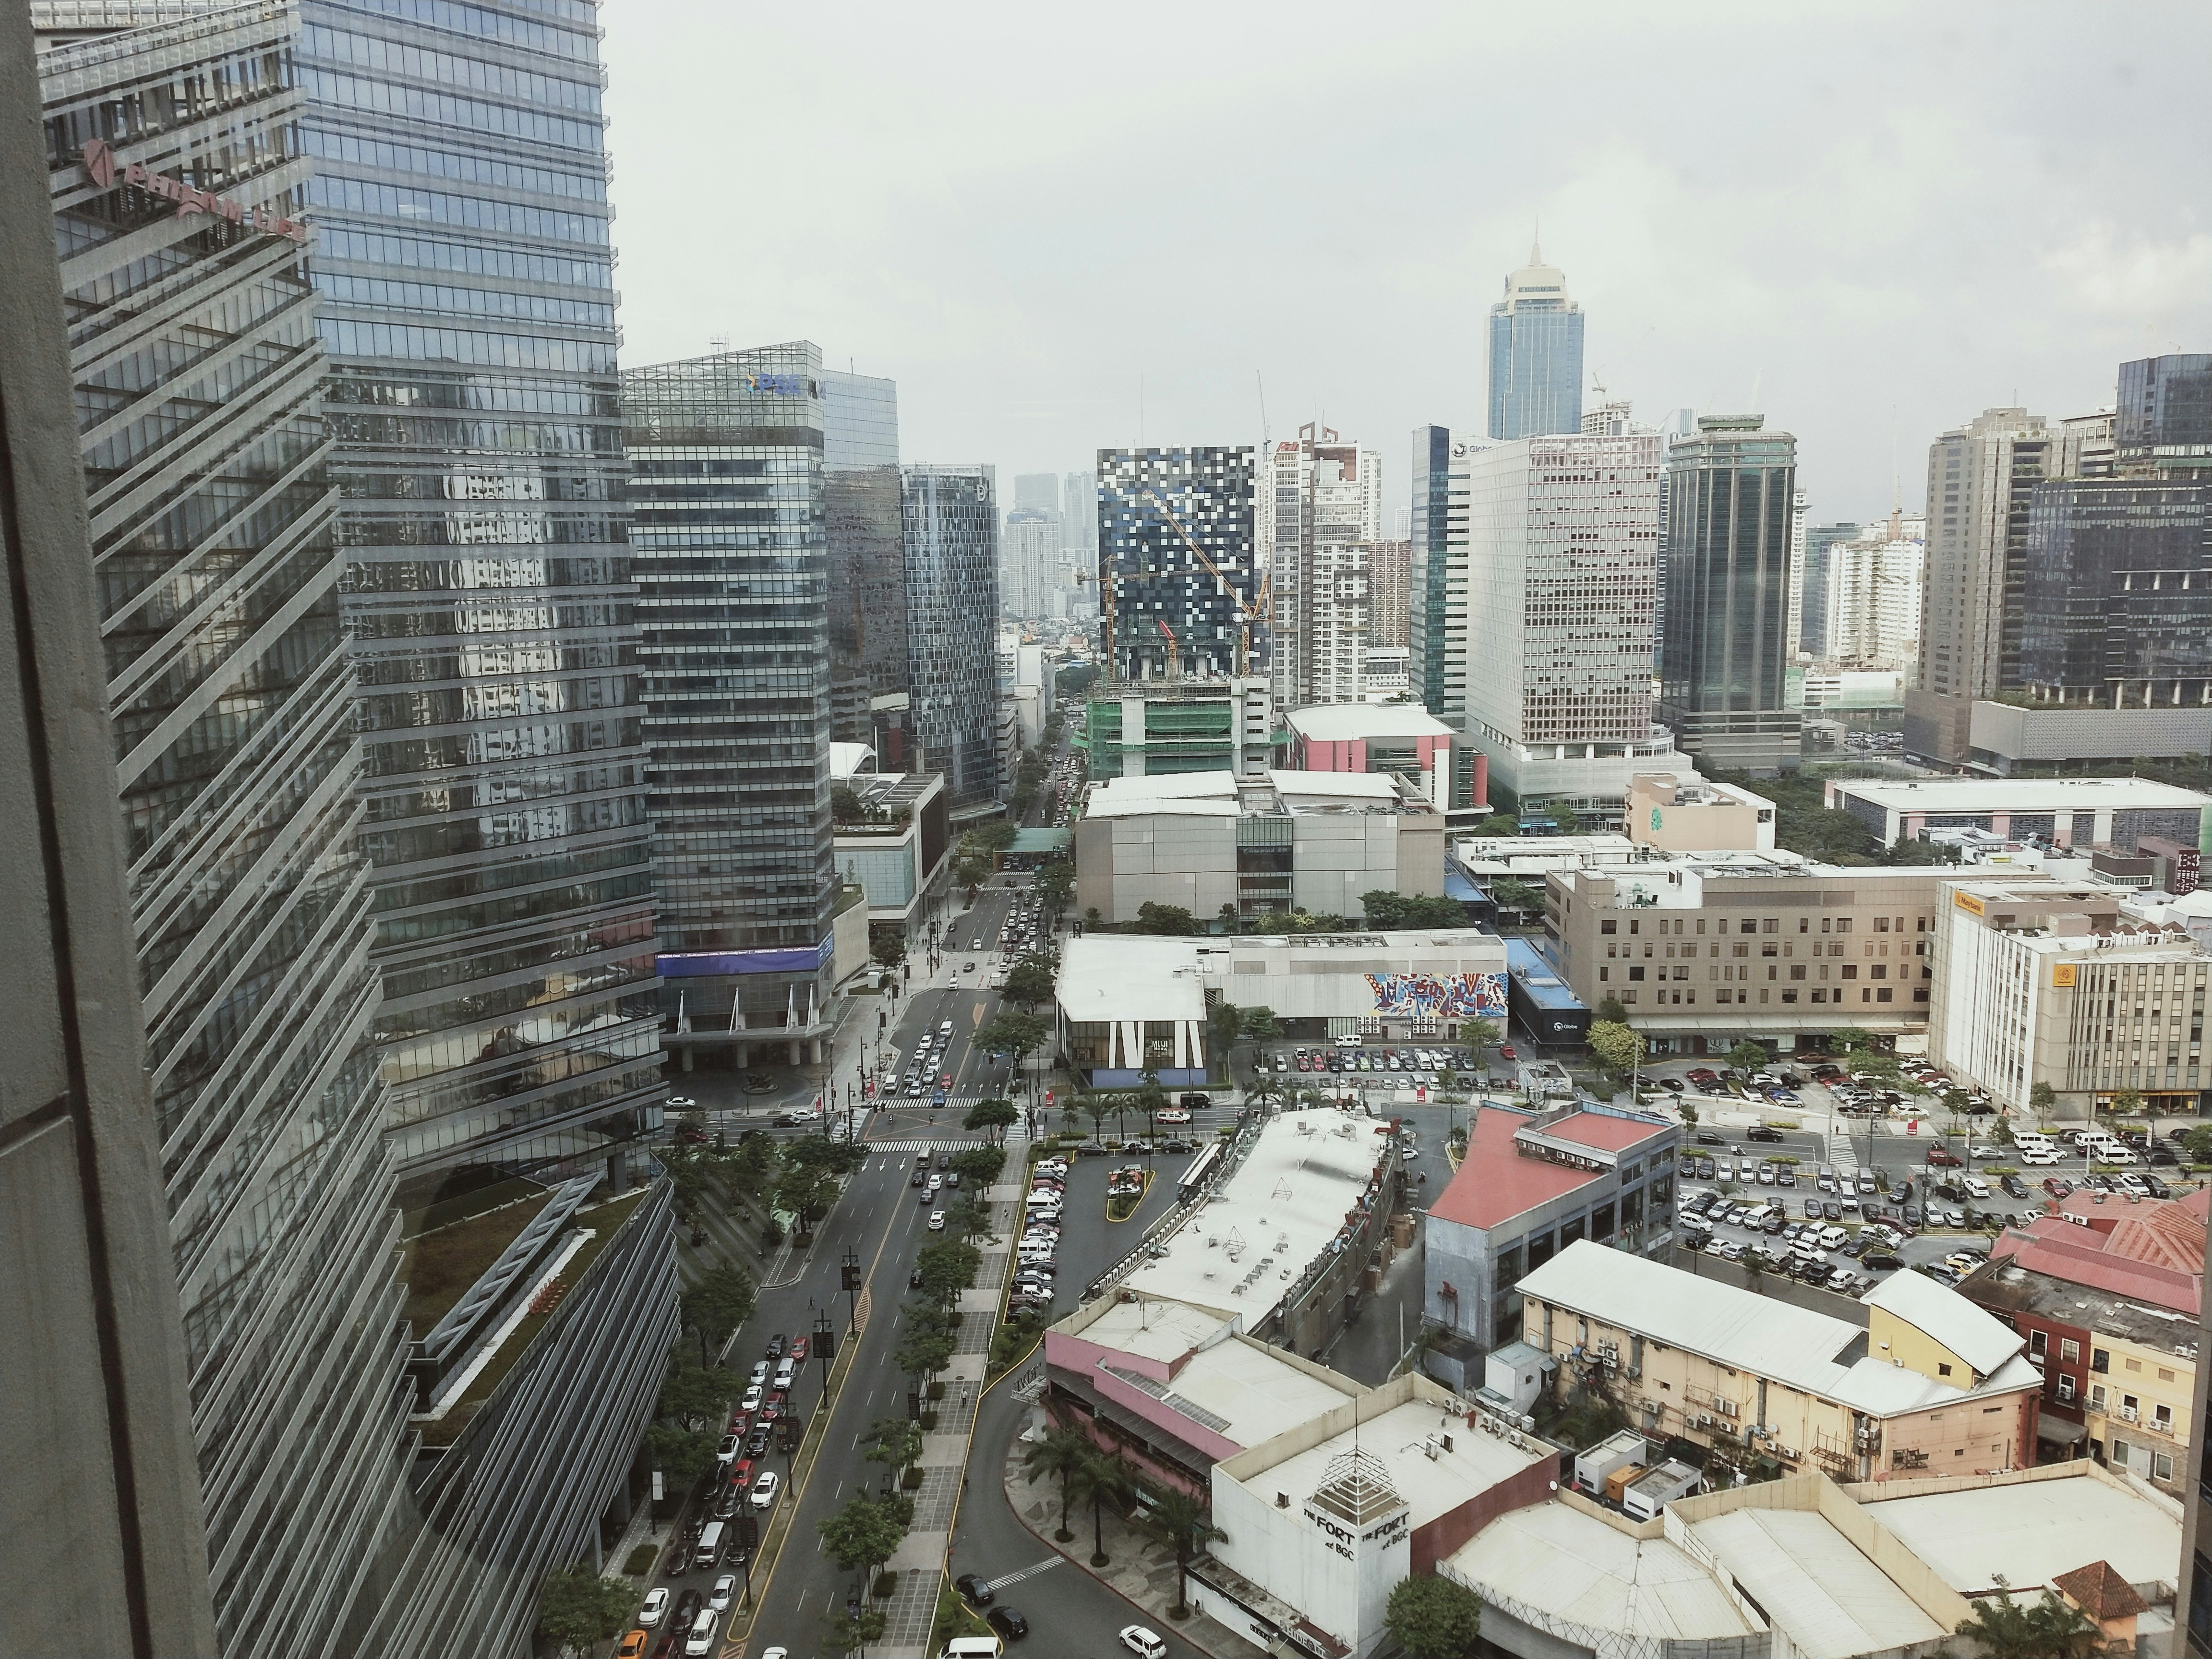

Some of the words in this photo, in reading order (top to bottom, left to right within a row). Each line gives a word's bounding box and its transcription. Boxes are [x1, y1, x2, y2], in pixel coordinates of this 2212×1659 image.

[253, 209, 306, 242] LIFE
[759, 373, 801, 395] PSE
[1961, 897, 1981, 912] Maybank
[1303, 1508, 1315, 1521] THE
[1317, 1516, 1355, 1545] FORT
[1362, 1531, 1373, 1542] THE
[1375, 1512, 1409, 1539] FORT
[1393, 1528, 1408, 1544] BGC
[1336, 1543, 1354, 1561] BGC
